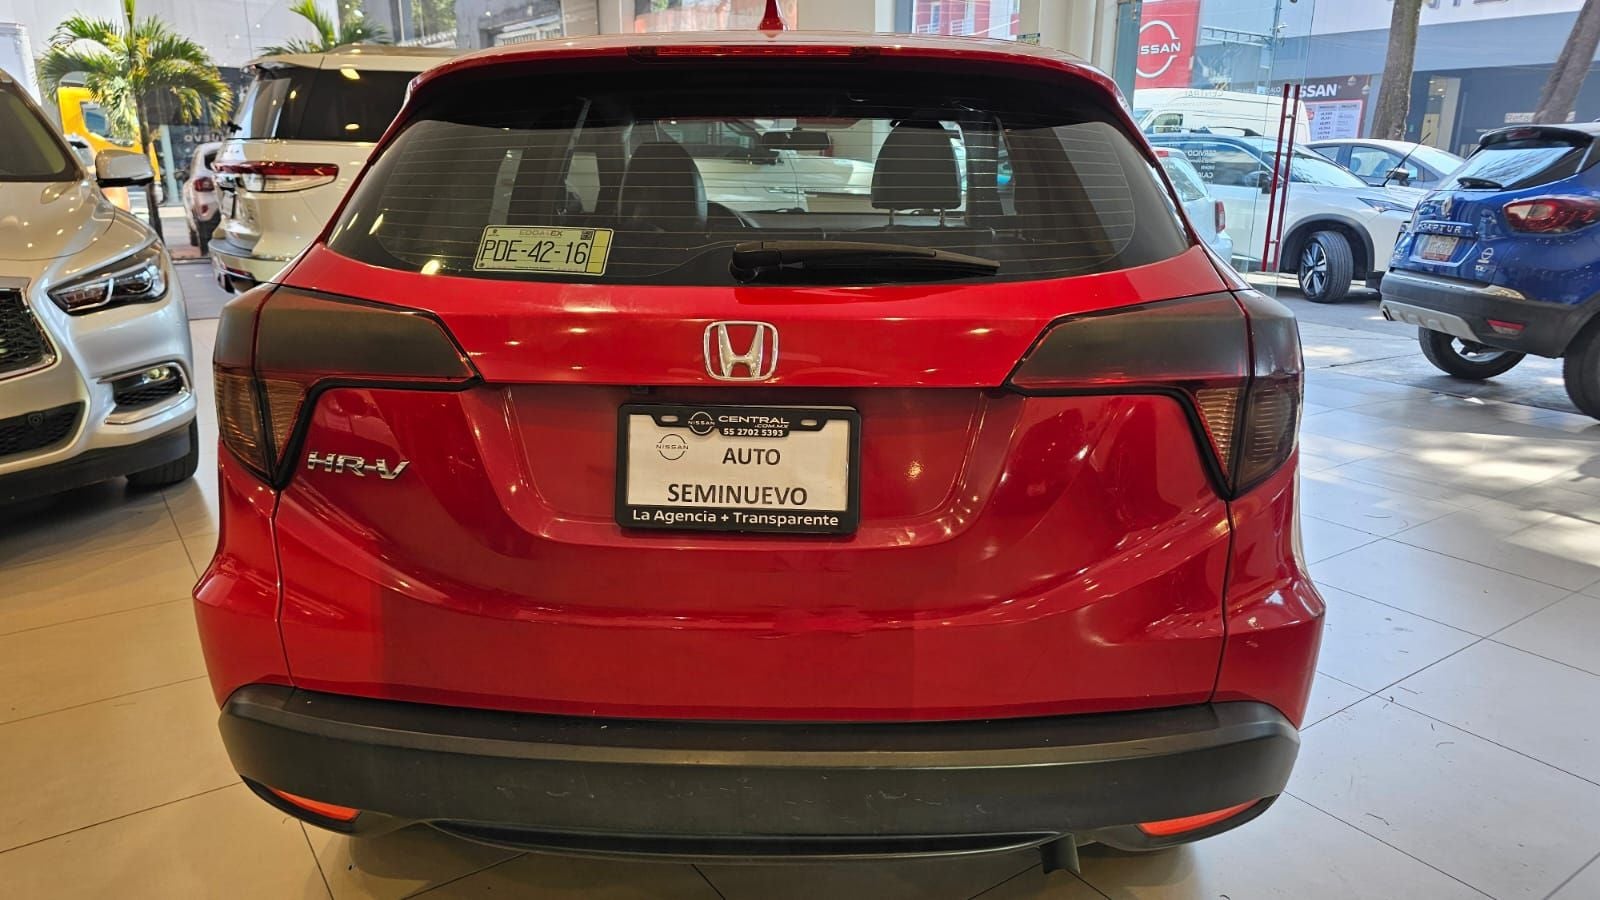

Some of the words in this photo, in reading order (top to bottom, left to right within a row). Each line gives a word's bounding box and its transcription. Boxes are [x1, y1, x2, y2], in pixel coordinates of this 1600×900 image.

[1138, 42, 1181, 55] SSAN
[480, 239, 589, 265] PDE-42-16
[718, 415, 790, 425] CENTRAL
[737, 428, 759, 436] 2702
[761, 429, 784, 437] 5393
[307, 451, 410, 479] HR-V
[722, 447, 781, 466] AUTO
[667, 483, 808, 506] SEMINUEVO
[633, 509, 650, 521] La
[654, 510, 717, 524] Agencia
[733, 512, 839, 527] Transparente
